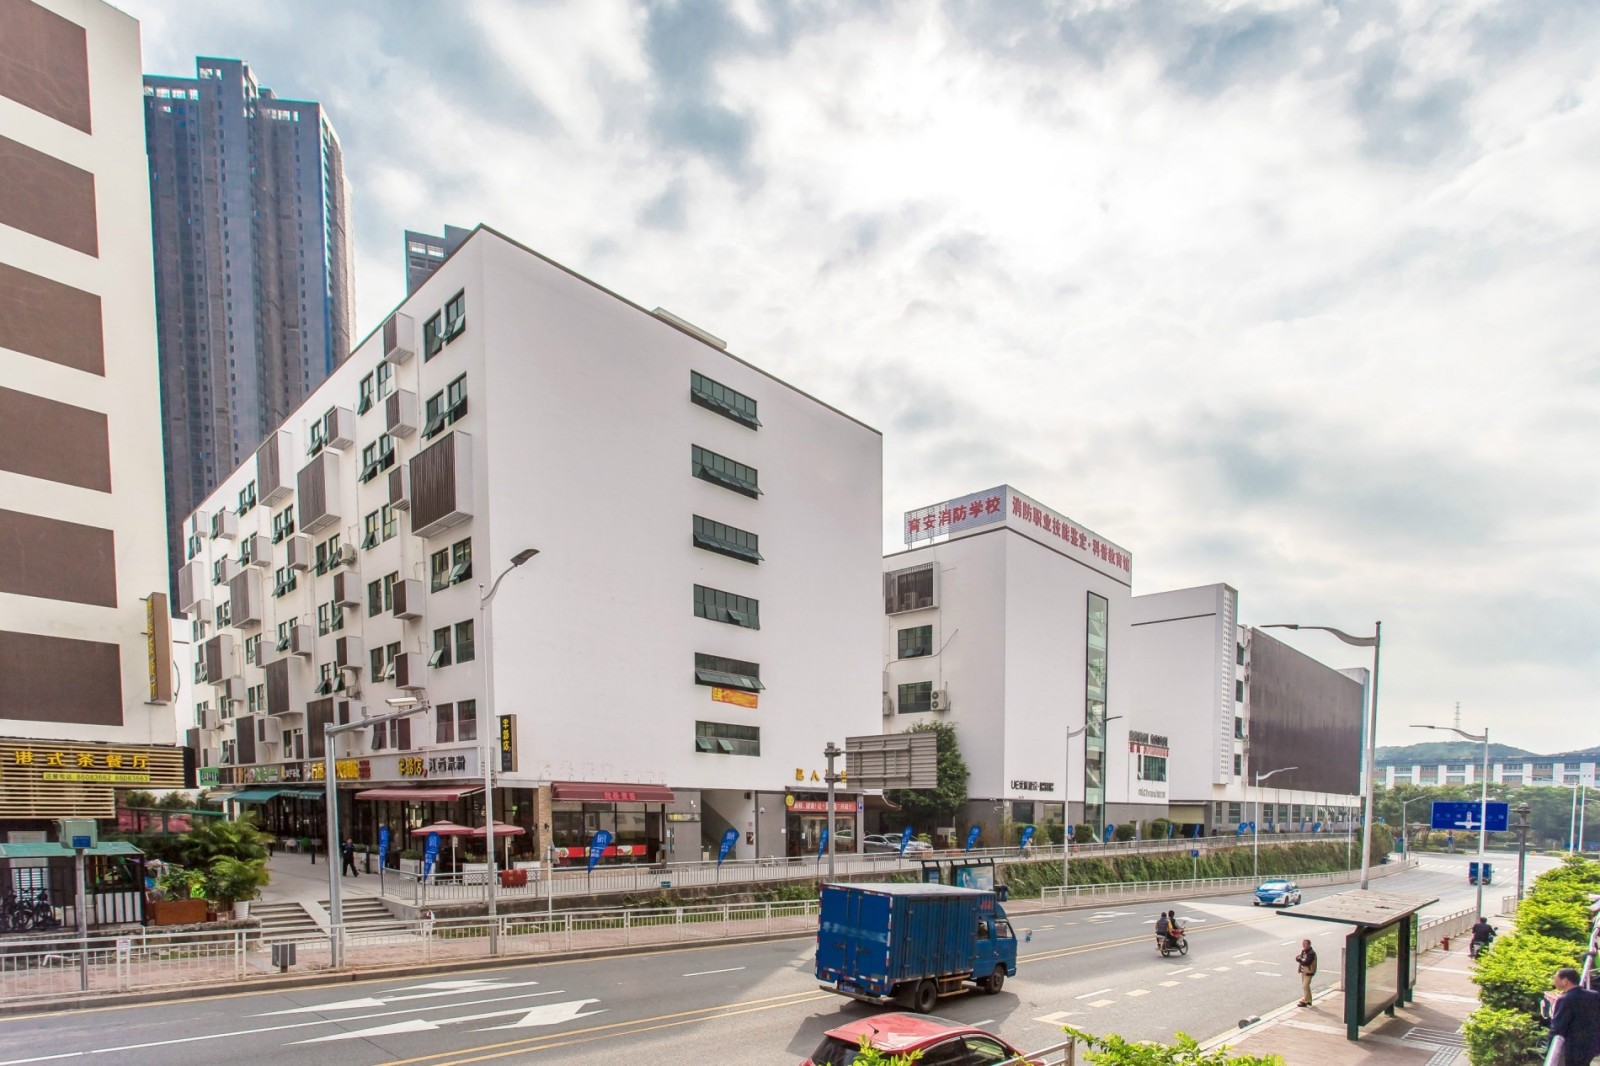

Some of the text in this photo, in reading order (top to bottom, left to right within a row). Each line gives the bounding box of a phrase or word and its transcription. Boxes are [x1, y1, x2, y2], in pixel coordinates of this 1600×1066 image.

[908, 495, 1000, 534] 育安消防学校
[15, 750, 150, 769] 港式茶餐厅
